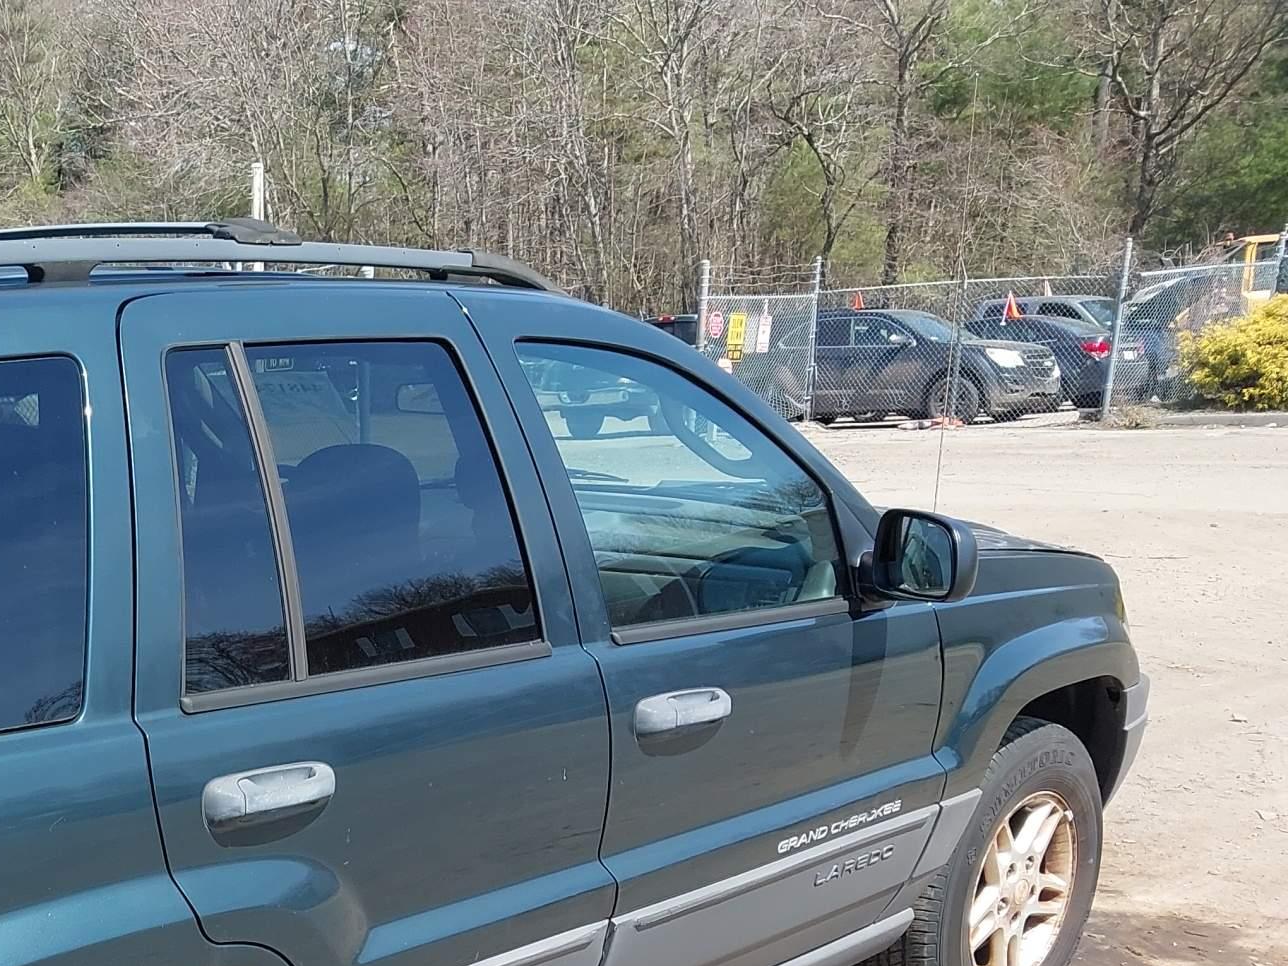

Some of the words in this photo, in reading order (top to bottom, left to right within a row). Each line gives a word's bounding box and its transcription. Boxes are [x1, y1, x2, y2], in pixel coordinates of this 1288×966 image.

[777, 825, 829, 854] GRAND
[830, 799, 902, 835] CHEROKEE
[814, 843, 896, 887] LAREDO
